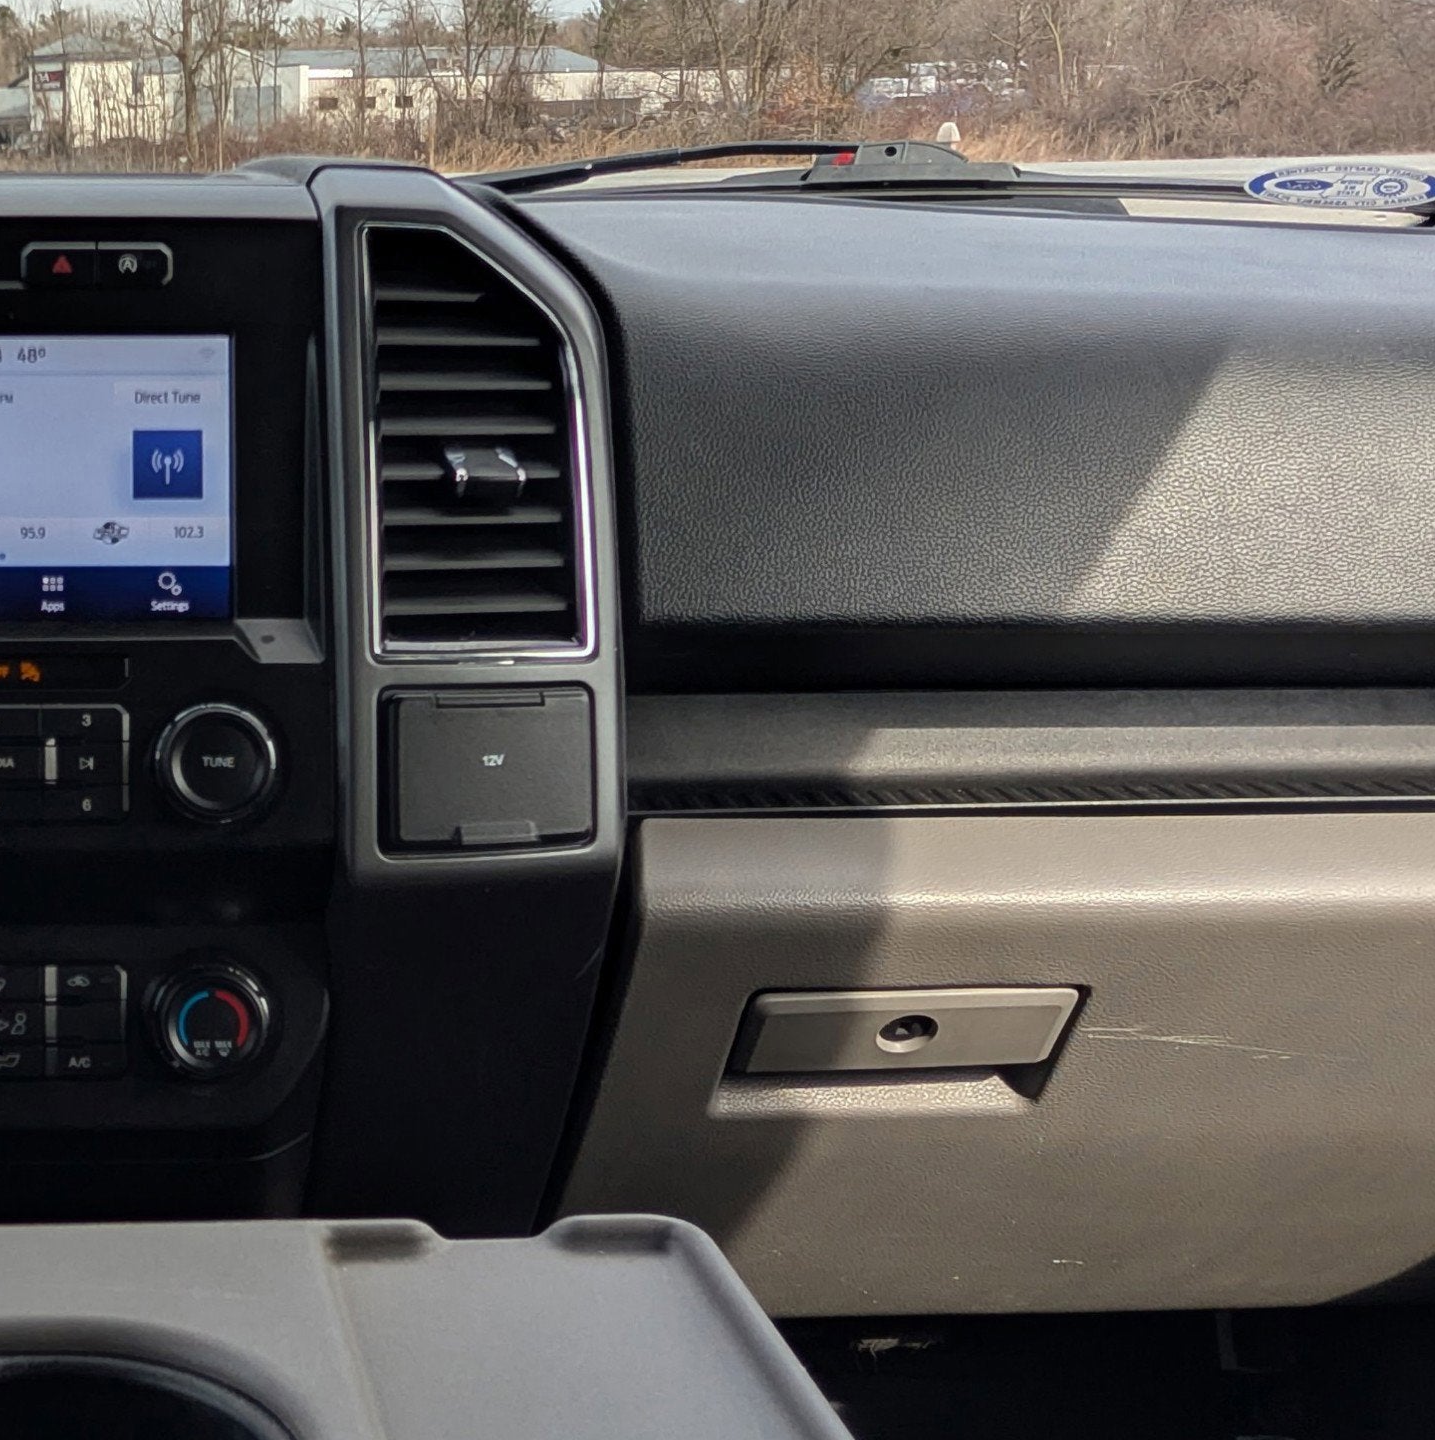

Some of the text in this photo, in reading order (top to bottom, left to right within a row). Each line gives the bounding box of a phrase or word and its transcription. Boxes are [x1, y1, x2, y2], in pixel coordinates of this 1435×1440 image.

[133, 390, 201, 405] Direct Tune
[19, 525, 47, 540] 95.9
[172, 525, 205, 540] 102.3
[40, 599, 65, 614] Apps
[150, 598, 190, 614] Settings
[81, 714, 92, 728] 3
[201, 756, 235, 769] TUNE
[481, 753, 506, 767] 12V
[81, 798, 92, 812] 6
[68, 1055, 92, 1069] A/C
